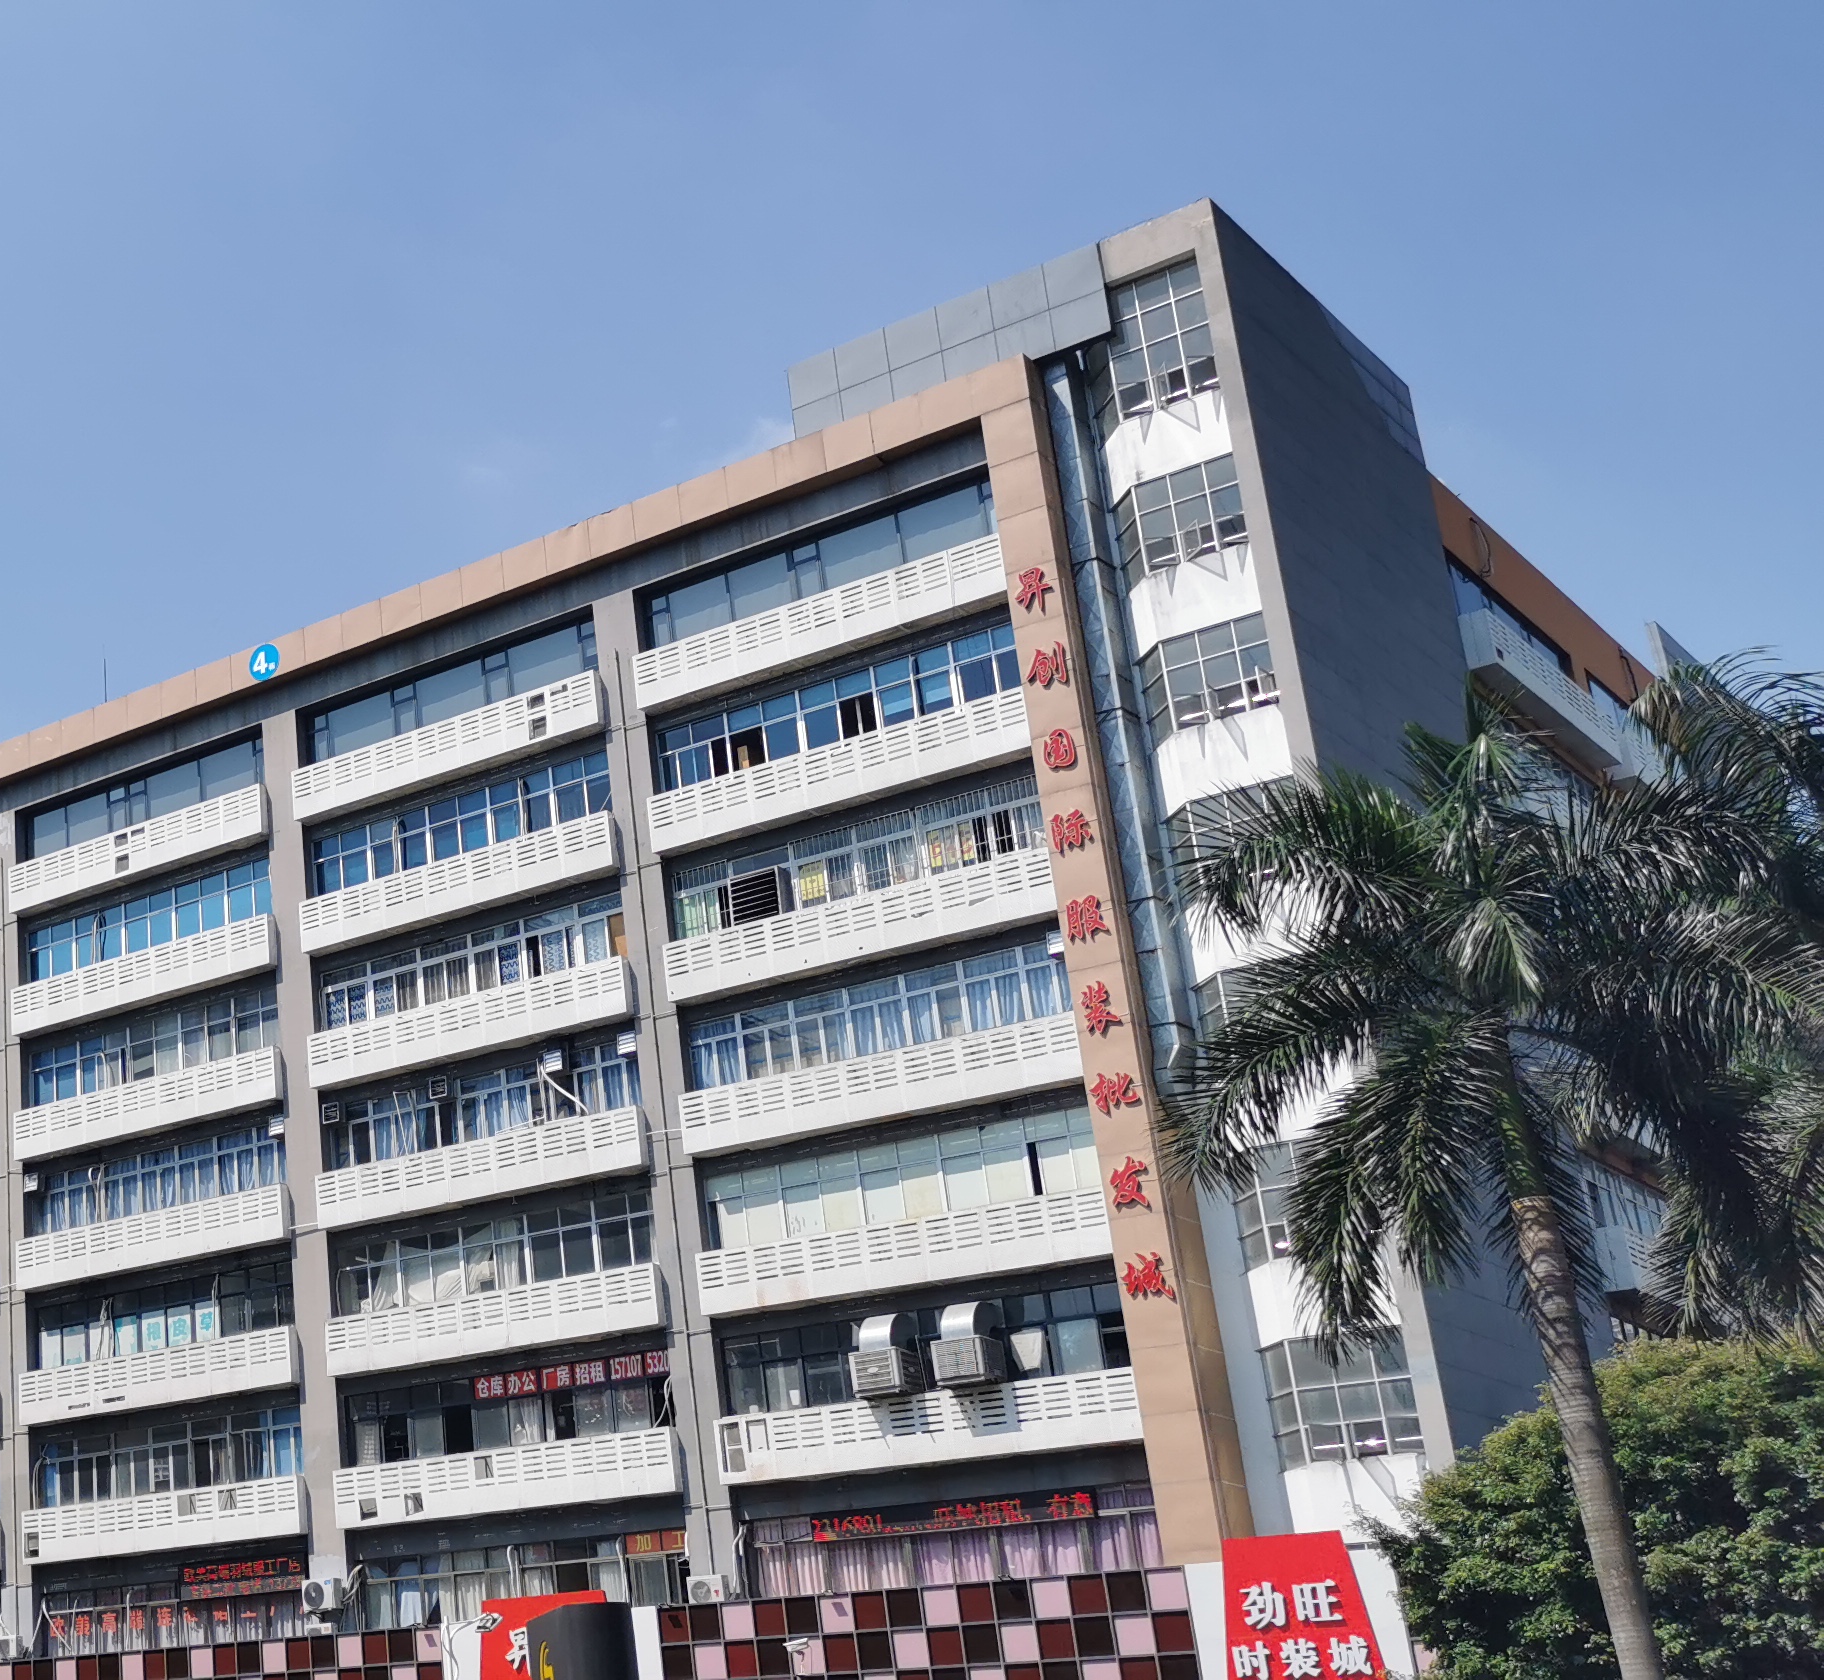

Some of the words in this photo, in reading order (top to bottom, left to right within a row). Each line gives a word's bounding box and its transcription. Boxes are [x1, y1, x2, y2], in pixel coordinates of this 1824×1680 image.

[1015, 566, 1175, 1302] 昇创国际服装批发城
[476, 1362, 606, 1398] 仓库办公厂房招租
[609, 1354, 642, 1380] 157107
[636, 1531, 685, 1552] 加工
[1239, 1579, 1343, 1630] 劲旺
[1231, 1634, 1373, 1680] 时装城
